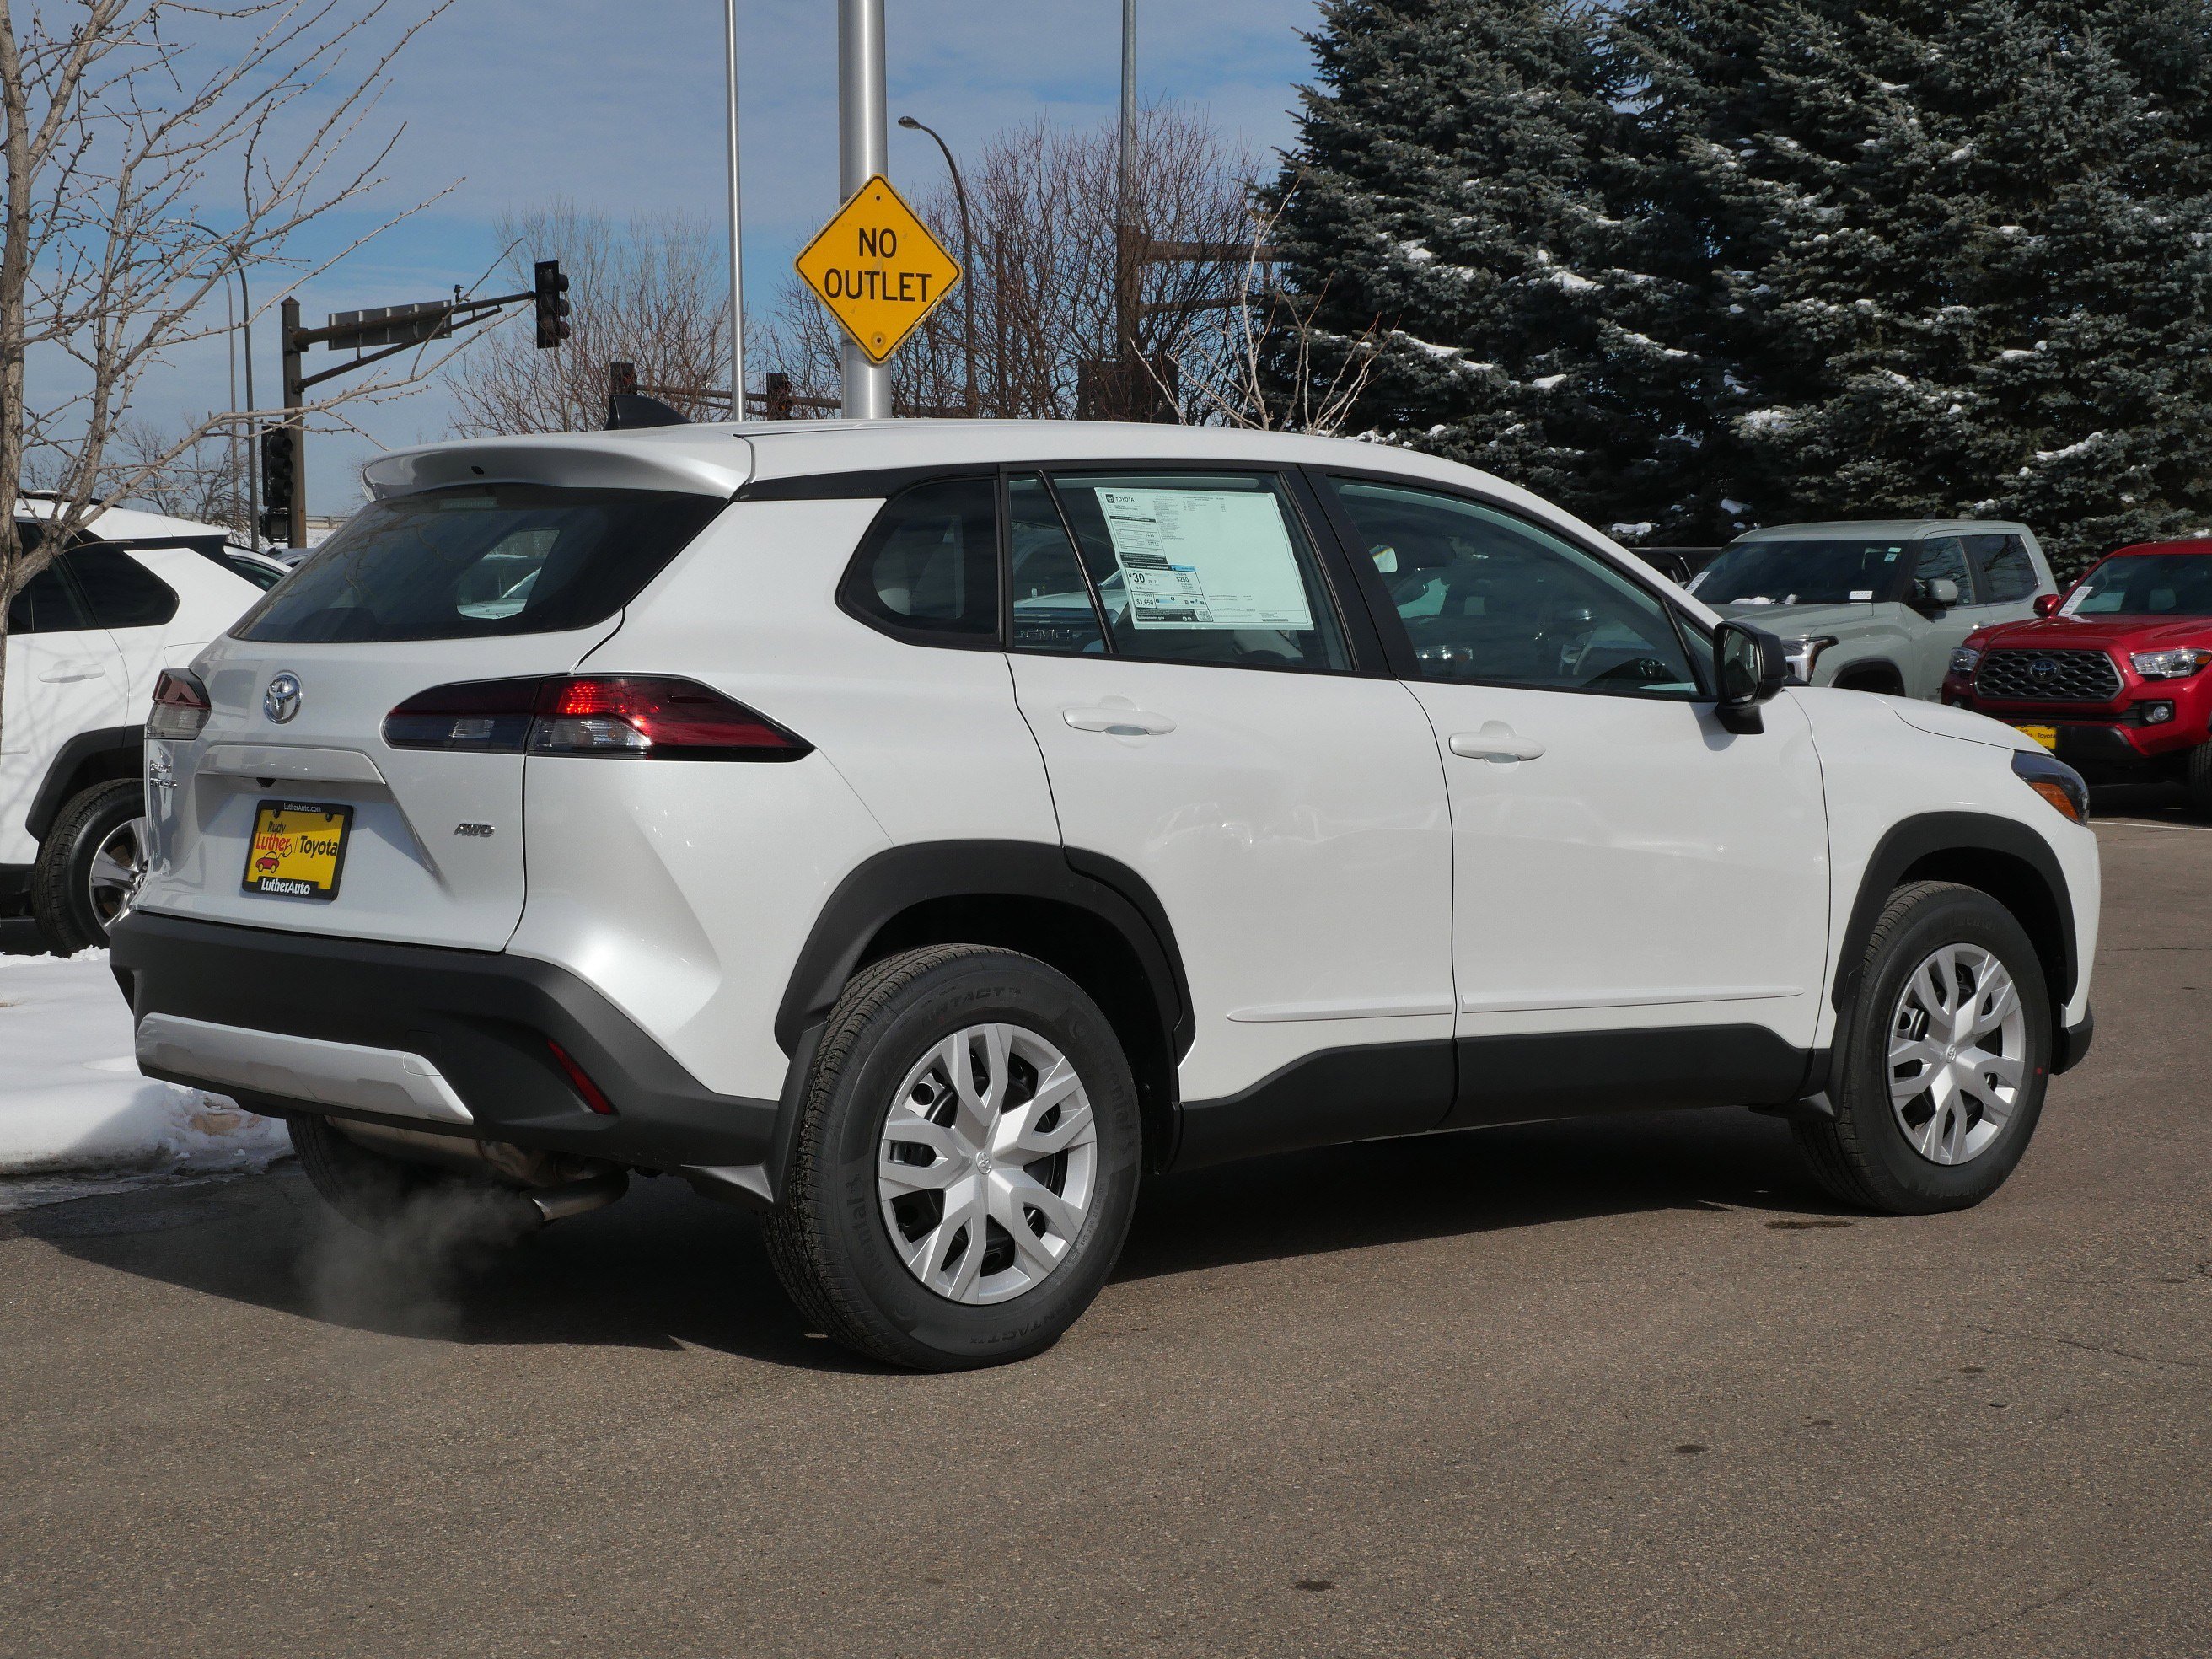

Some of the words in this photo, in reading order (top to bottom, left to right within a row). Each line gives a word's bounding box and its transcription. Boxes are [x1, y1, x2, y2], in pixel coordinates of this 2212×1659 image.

[858, 228, 897, 258] NO
[824, 268, 932, 303] OUTLET
[1132, 572, 1145, 583] 30
[283, 803, 322, 813] LutherAuto.com
[267, 820, 287, 835] Rudy
[454, 823, 496, 838] AWD
[255, 831, 291, 851] Luther
[299, 835, 338, 859] Toyota
[260, 877, 311, 895] LutherAuto
